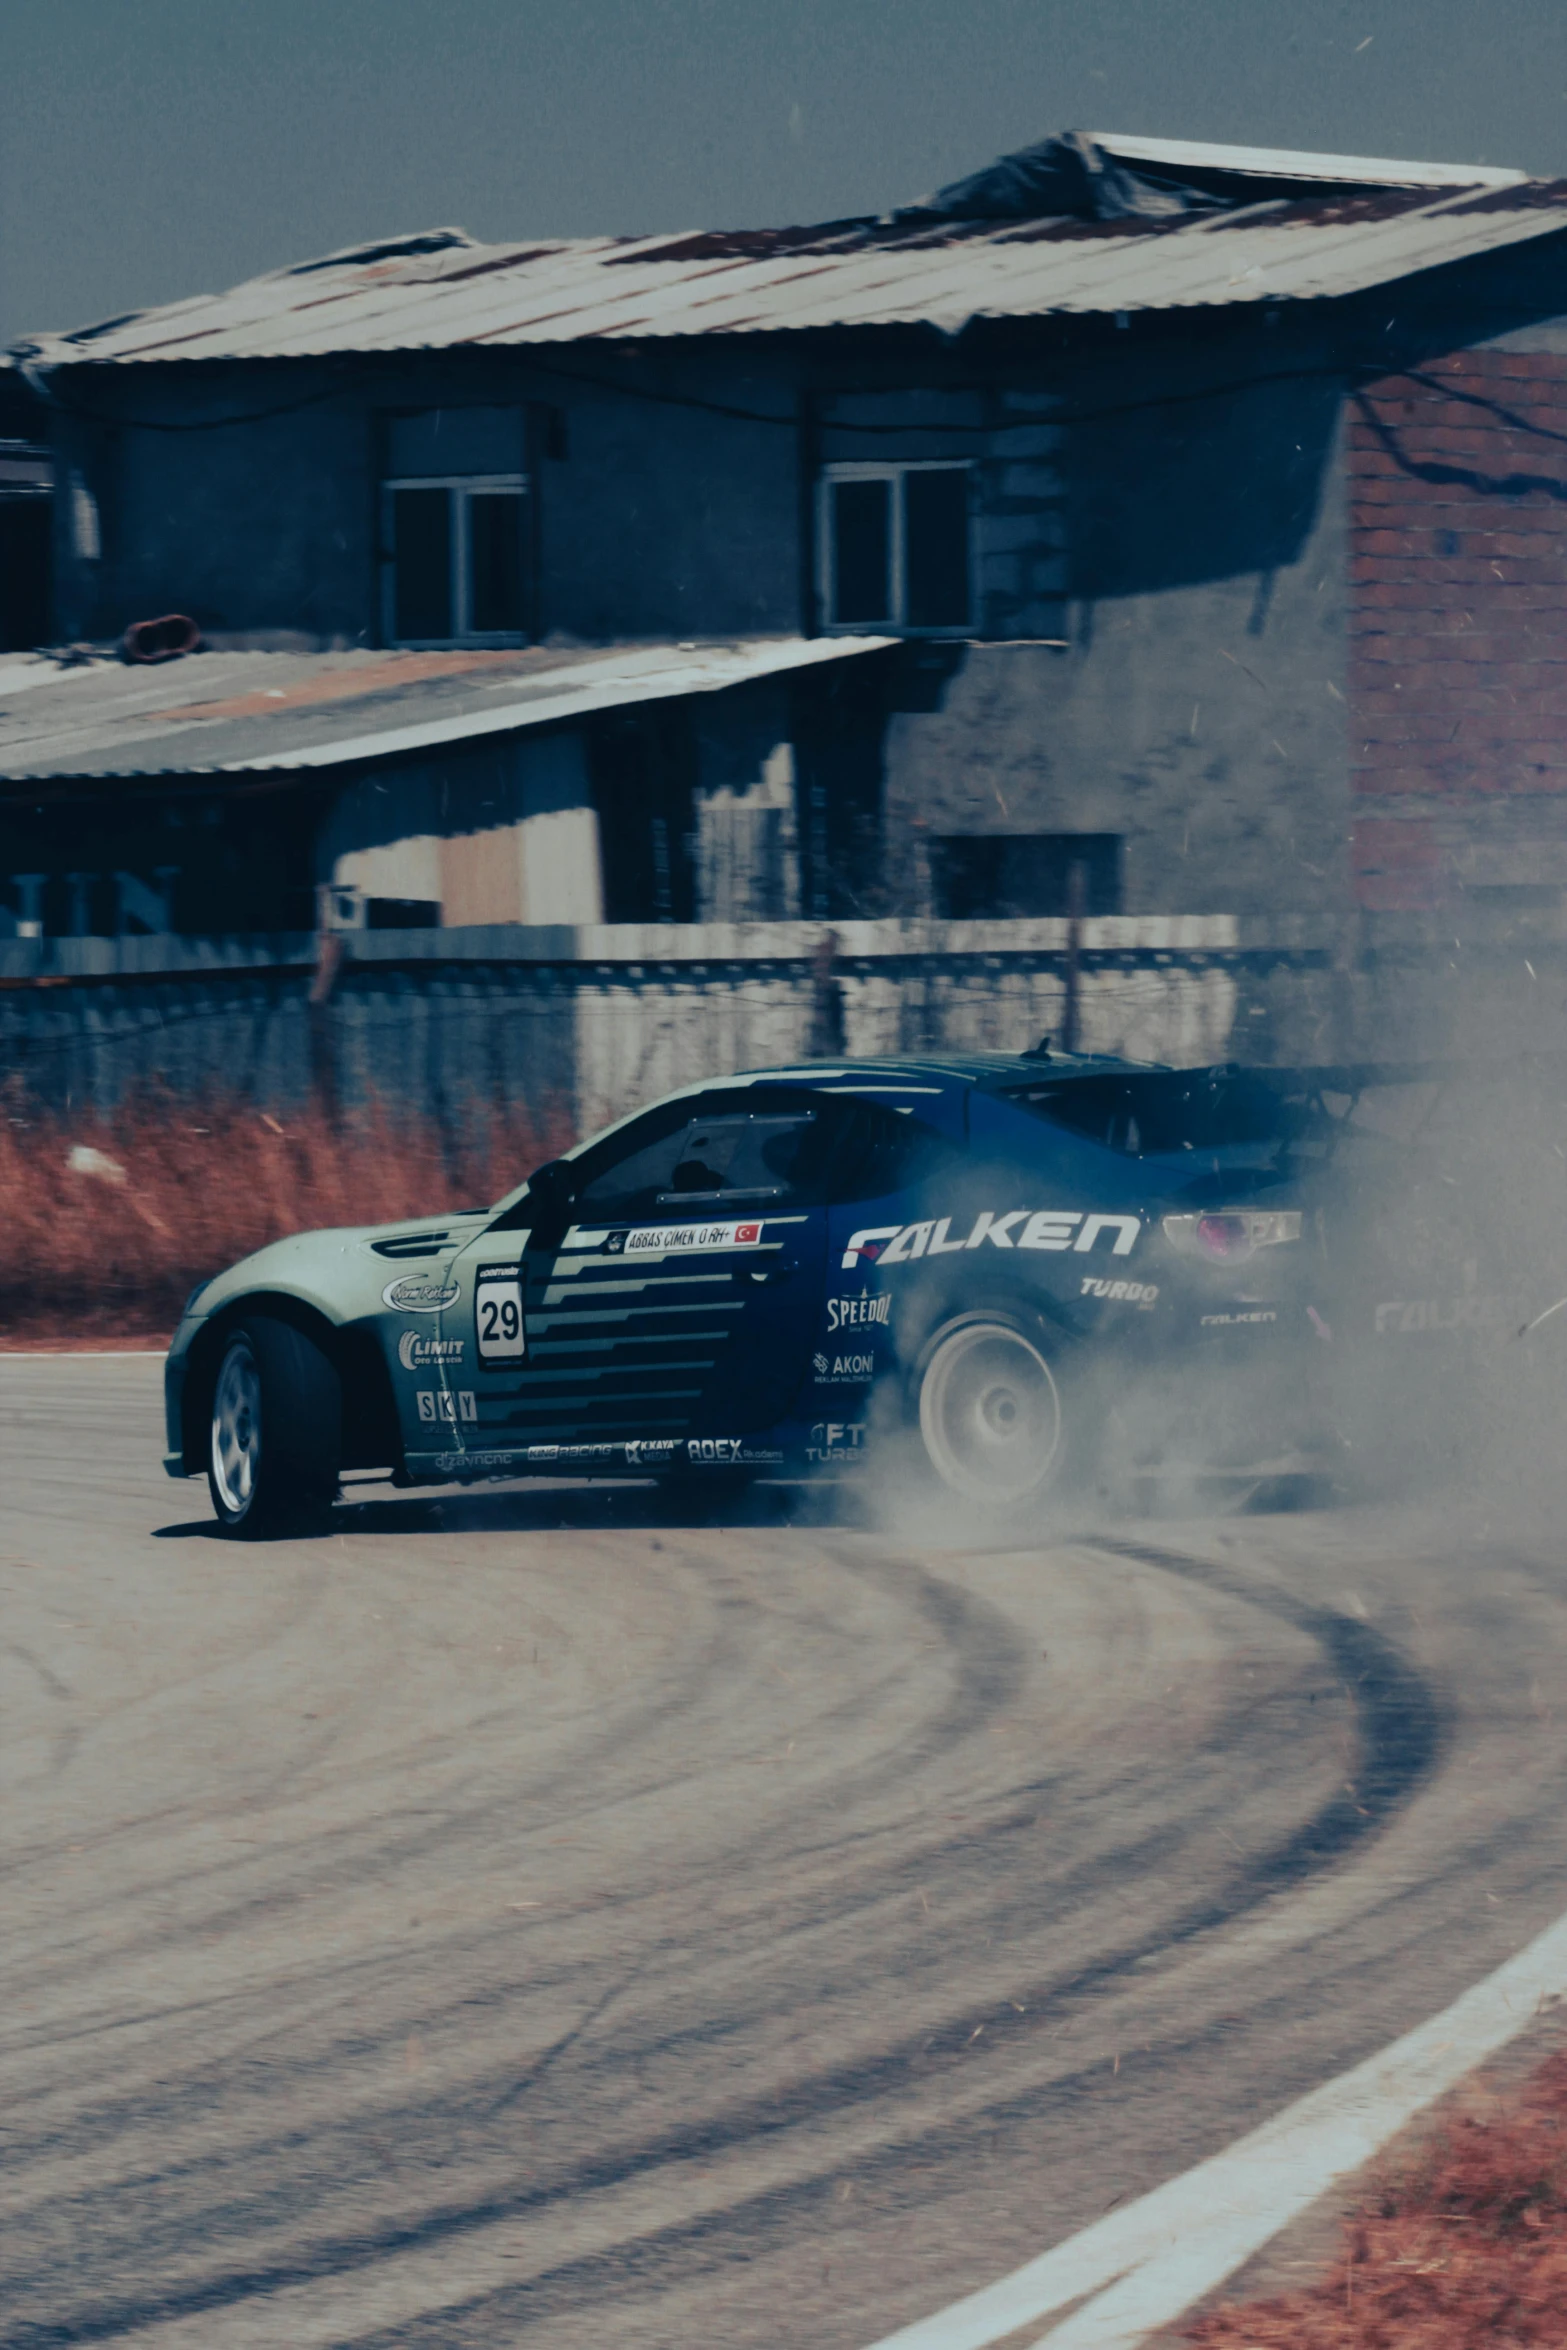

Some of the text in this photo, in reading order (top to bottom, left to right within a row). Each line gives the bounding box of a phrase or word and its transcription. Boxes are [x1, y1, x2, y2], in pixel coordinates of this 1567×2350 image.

[628, 1232, 661, 1248] ABBAS
[841, 1211, 1141, 1269] FALKEN
[1080, 1278, 1159, 1302] TURBO
[481, 1300, 519, 1342] 29
[827, 1293, 893, 1333] SPEEDOL
[1200, 1312, 1277, 1326] FALKEN
[419, 1393, 474, 1419] SKY
[826, 1423, 867, 1446] FT
[528, 1446, 559, 1460] KING
